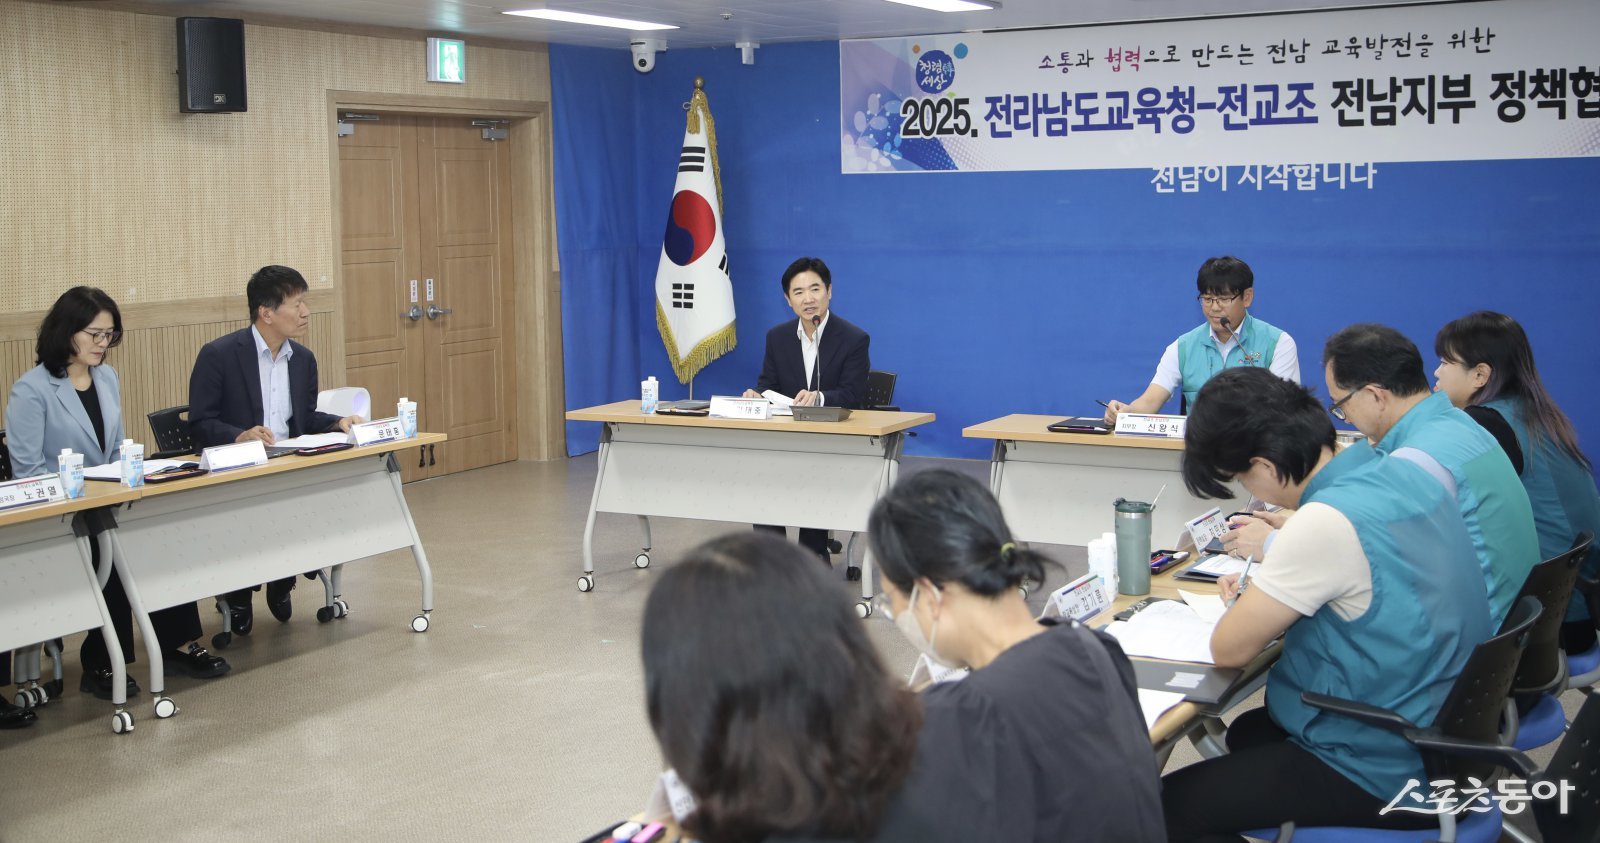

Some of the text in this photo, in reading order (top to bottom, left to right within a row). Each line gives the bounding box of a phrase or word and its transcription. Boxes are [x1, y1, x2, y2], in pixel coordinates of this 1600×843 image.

[1038, 26, 1496, 74] 소통과 협력으로 만드는 전남 교육발전을 위한
[920, 73, 948, 90] 세상
[901, 98, 978, 139] 2025.
[1330, 74, 1477, 128] 전남지부
[1237, 161, 1378, 192] 시작합니다
